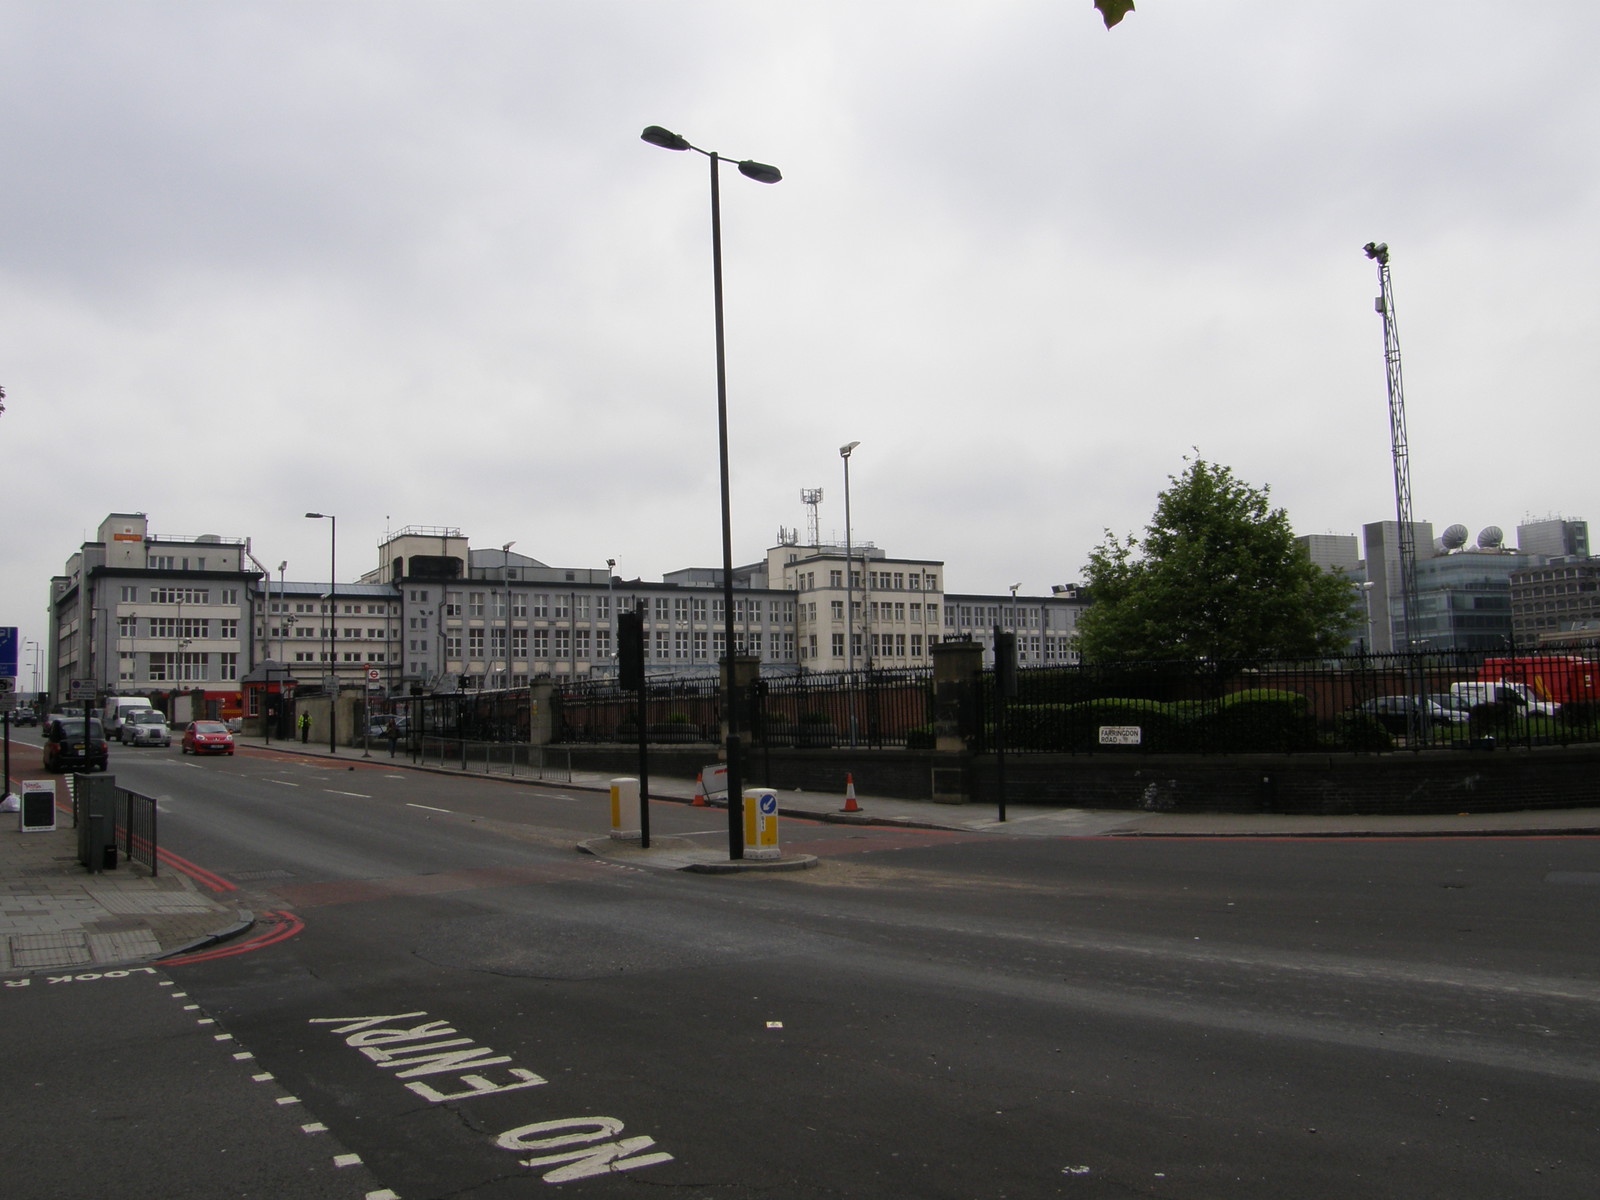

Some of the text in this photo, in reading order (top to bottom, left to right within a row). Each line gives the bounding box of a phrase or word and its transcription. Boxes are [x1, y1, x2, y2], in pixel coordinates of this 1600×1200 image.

[1101, 729, 1139, 737] FARRINGDON
[46, 967, 157, 984] LOOK
[308, 1010, 675, 1184] NO ENTRY
